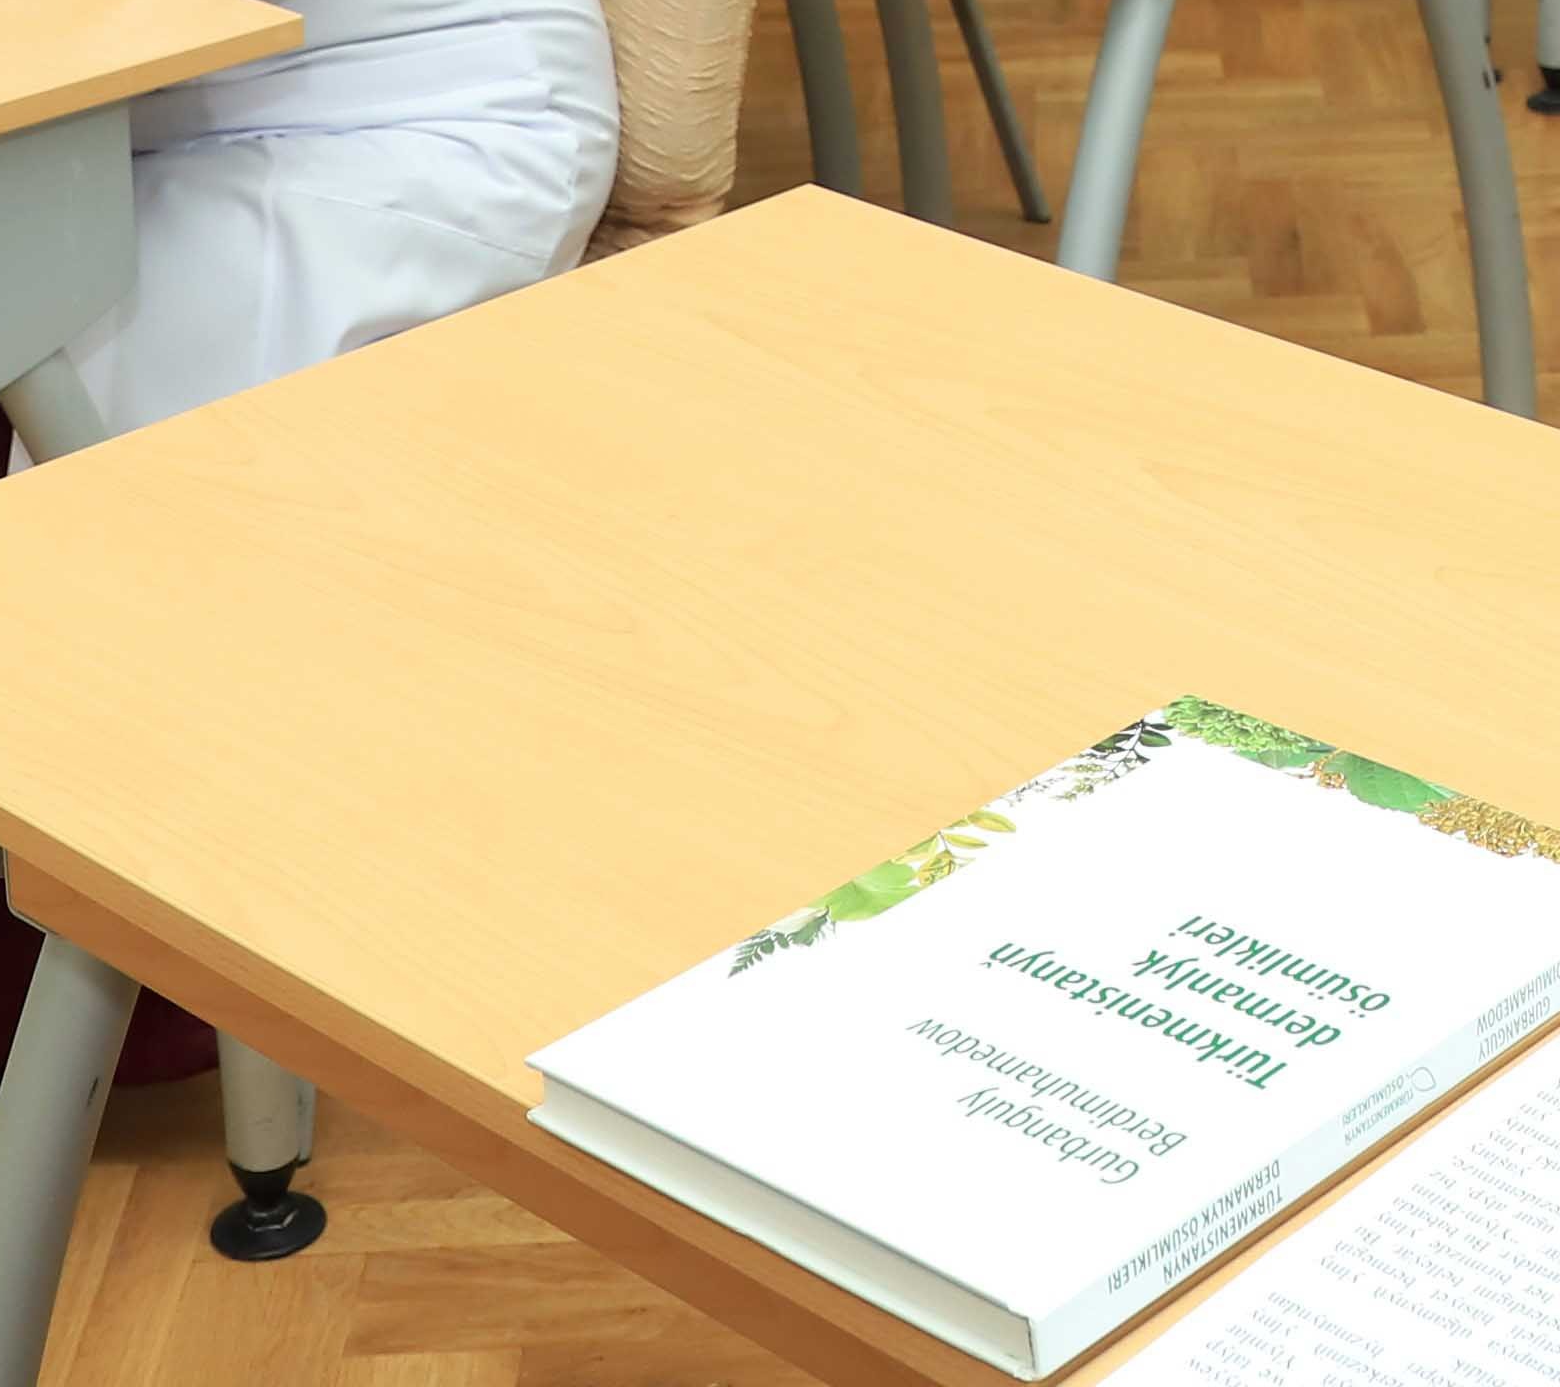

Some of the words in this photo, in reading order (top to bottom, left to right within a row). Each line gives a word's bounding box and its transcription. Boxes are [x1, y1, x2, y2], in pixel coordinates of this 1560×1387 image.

[1131, 949, 1342, 1050] dermanlyk
[1168, 915, 1390, 1017] ösümlikleri
[979, 942, 1288, 1090] Türkmenistanyň
[1478, 996, 1551, 1060] GURBANGULY
[905, 1018, 1187, 1157] Berdimuhamedow
[956, 1087, 1139, 1186] Gurbanguly
[1162, 1186, 1284, 1285] TÜRKMENISTANYŇ
[1200, 1160, 1281, 1233] DERMANLYK
[1106, 1214, 1202, 1294] ÖSÜMLIKLERI
